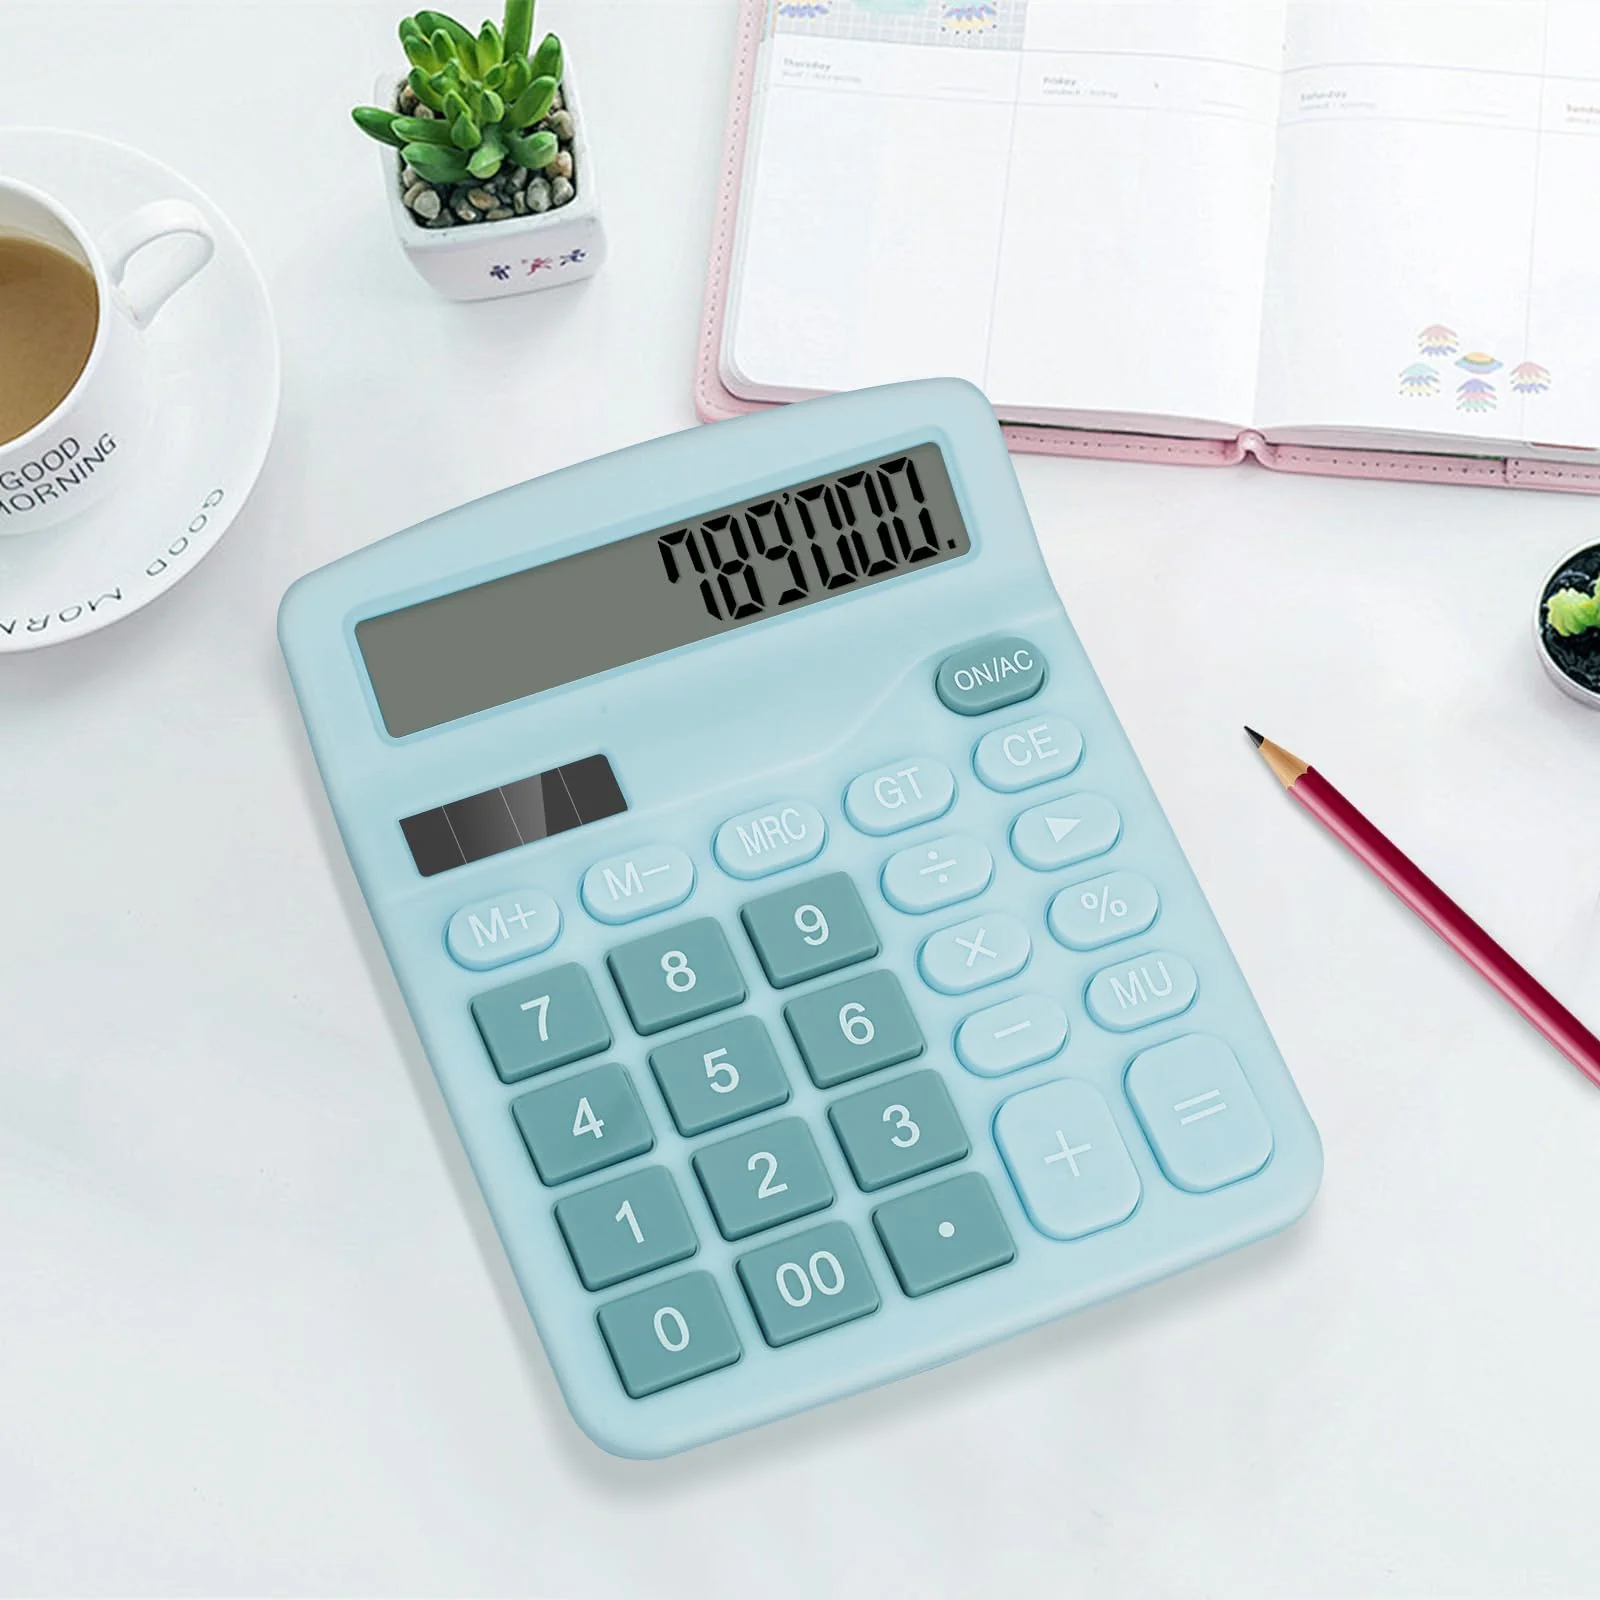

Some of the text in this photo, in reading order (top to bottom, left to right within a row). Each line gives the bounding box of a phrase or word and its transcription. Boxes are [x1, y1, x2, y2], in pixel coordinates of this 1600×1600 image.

[1043, 75, 1077, 86] Friday
[0, 436, 81, 492] GOOD
[145, 488, 225, 577] GOOD
[954, 649, 1033, 691] ON/AC
[1003, 724, 1060, 766] CE
[873, 766, 924, 809] GT
[735, 808, 806, 857] MRC
[468, 903, 537, 948] M+
[794, 904, 829, 946] 9
[1080, 885, 1128, 923] %
[660, 950, 697, 993] 8
[1110, 960, 1173, 1009] MU
[520, 994, 550, 1042] 7
[838, 1002, 875, 1045] 6
[703, 1047, 740, 1093] 5
[571, 1096, 605, 1139] 4
[882, 1104, 920, 1148] 3
[1173, 1088, 1227, 1125] =
[747, 1151, 788, 1199] 2
[1043, 1129, 1092, 1177] +
[615, 1199, 645, 1244] 1
[775, 1250, 845, 1307] 00
[653, 1306, 690, 1352] 0
